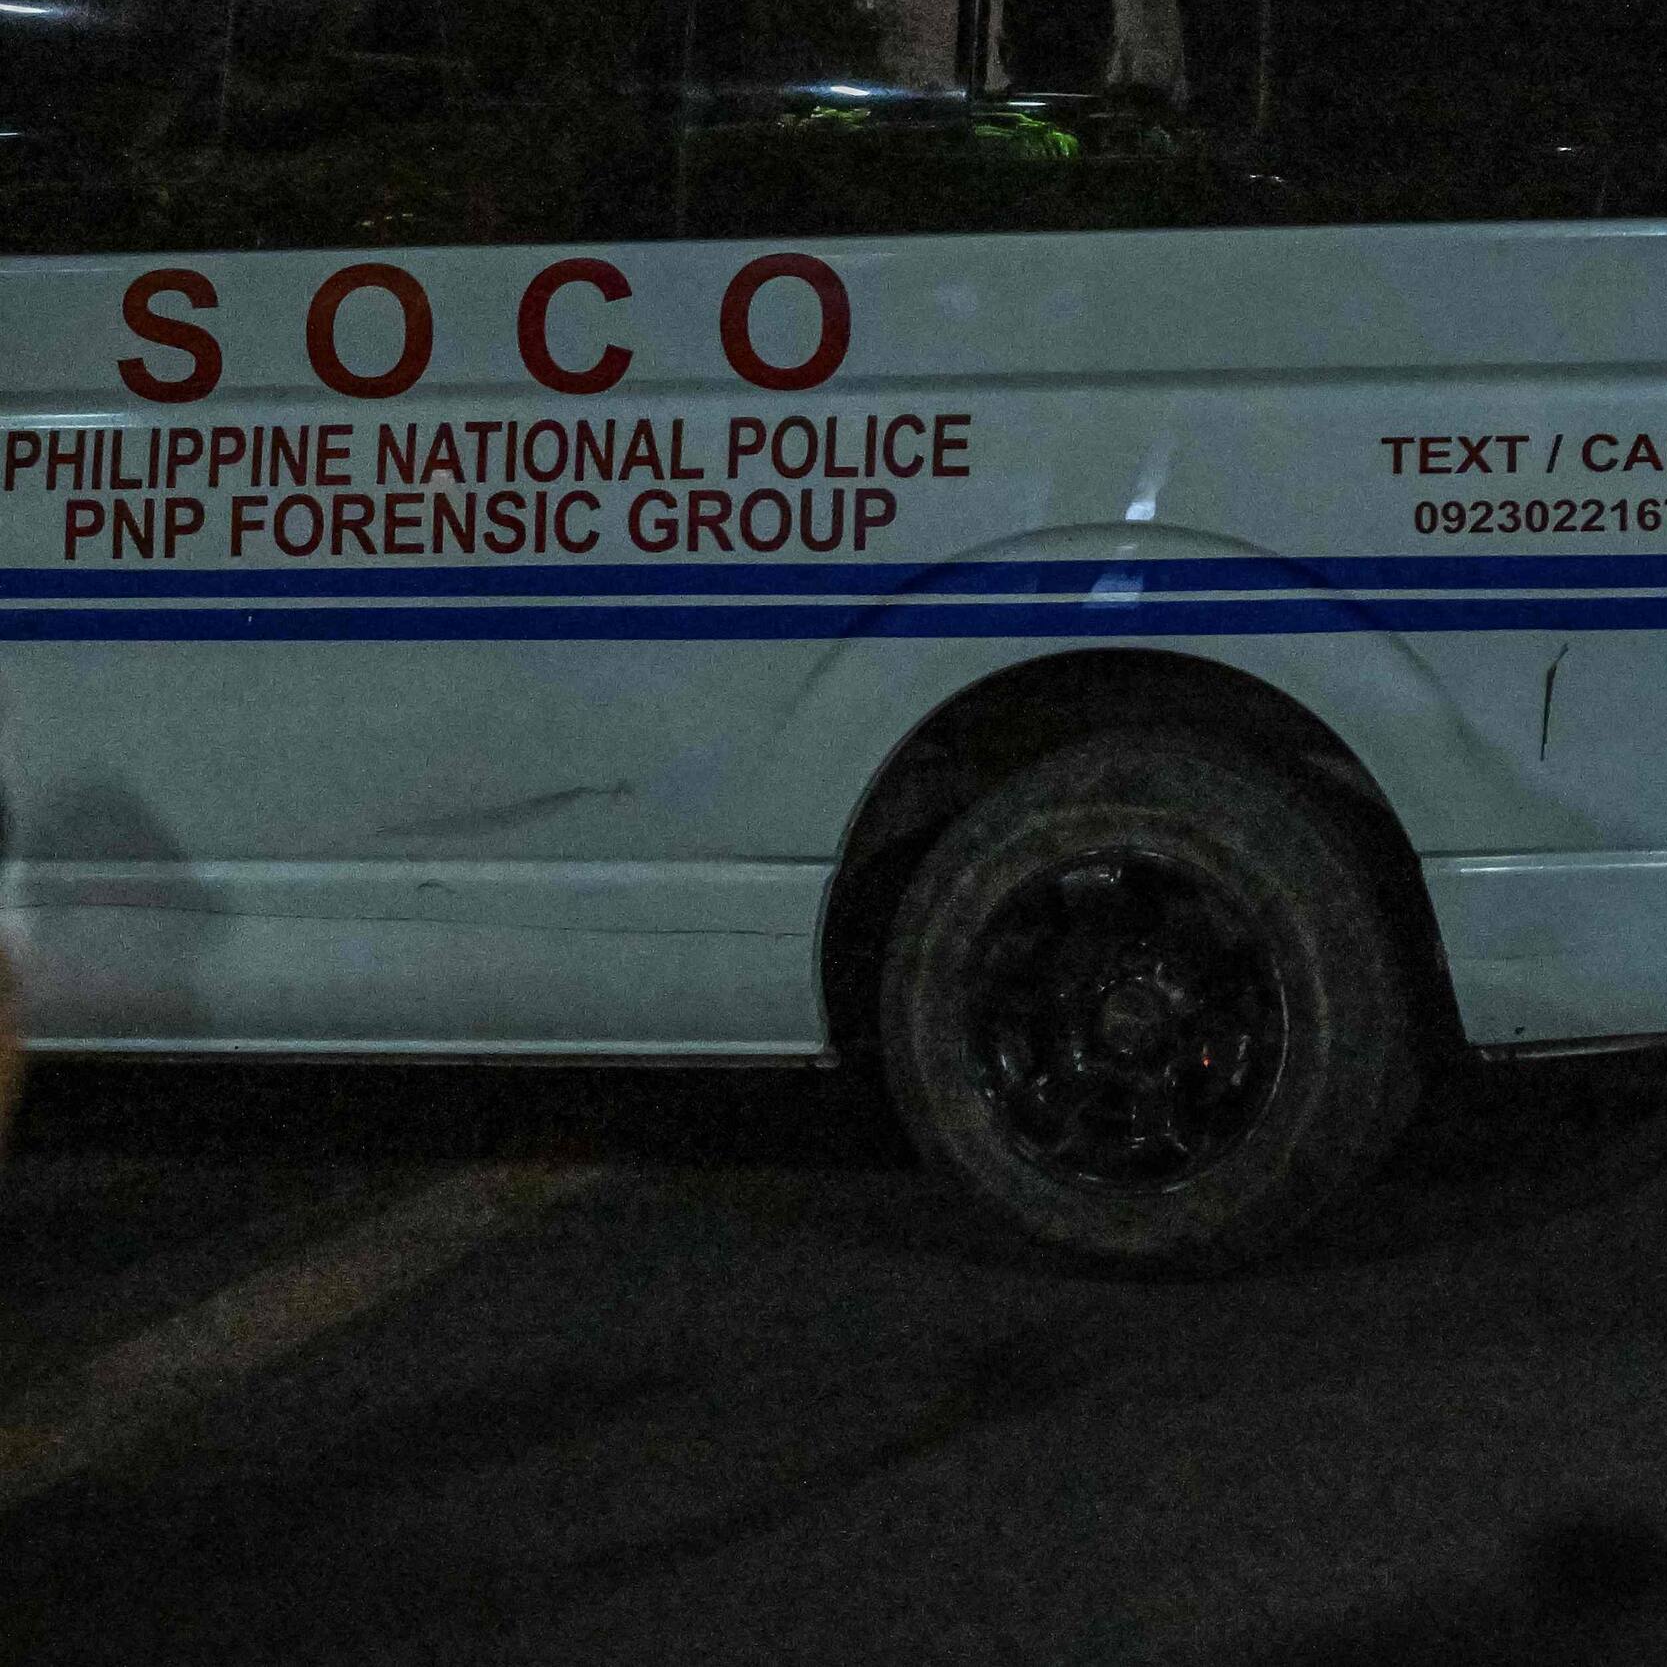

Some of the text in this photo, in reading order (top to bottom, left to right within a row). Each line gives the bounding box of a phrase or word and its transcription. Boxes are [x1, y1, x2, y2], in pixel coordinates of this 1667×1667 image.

[116, 251, 852, 404] SOCO
[3, 413, 972, 492] PHILIPPINE NATIONAL POLICE
[1380, 433, 1531, 475] TEXT
[1545, 433, 1564, 474] /
[64, 487, 898, 561] PNP FORENSIC GROUP
